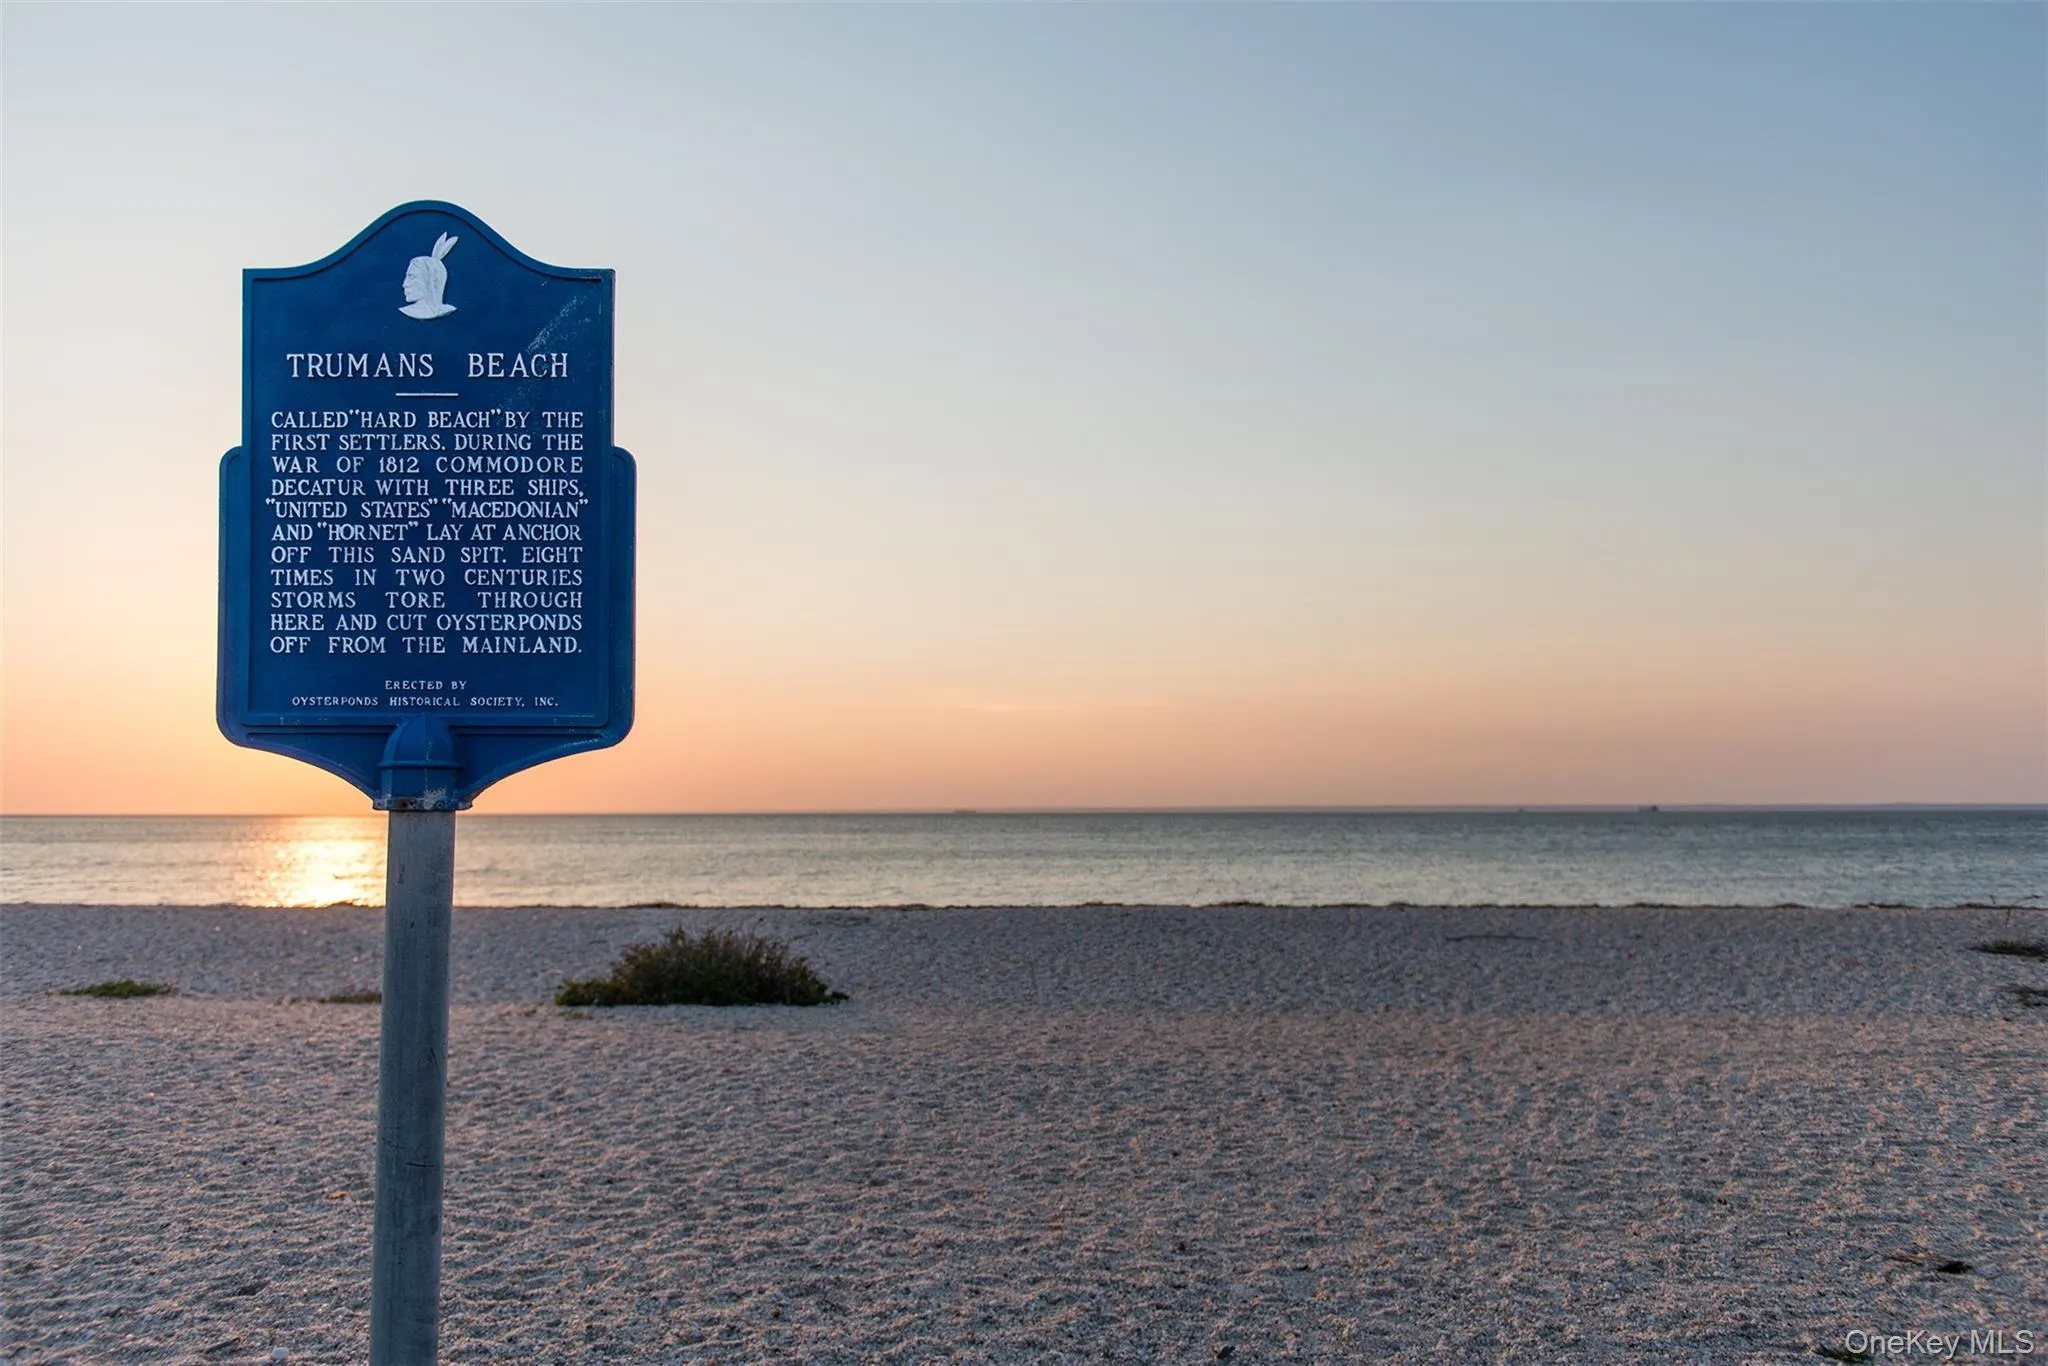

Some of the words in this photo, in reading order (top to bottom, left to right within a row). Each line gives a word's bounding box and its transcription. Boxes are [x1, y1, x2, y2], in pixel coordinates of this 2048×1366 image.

[286, 352, 434, 378] TRUMANS
[468, 352, 568, 378] BEACH
[271, 411, 349, 429] CALLED
[504, 411, 531, 428] BY
[542, 411, 584, 429] THE
[271, 433, 331, 451] FIRST
[338, 433, 446, 451] SETTLERS.
[454, 433, 532, 451] DURING
[542, 433, 584, 451] THE
[271, 455, 320, 474] WAR
[336, 456, 364, 473] OF
[379, 456, 420, 473] 1812
[435, 455, 583, 474] COMMODORE
[271, 478, 366, 496] DECATUR
[374, 478, 429, 496] WITH
[444, 478, 515, 496] THREE
[527, 478, 584, 498] SHIPS,
[271, 523, 313, 542] AND
[426, 523, 462, 541] LAY
[470, 523, 497, 541] AT
[502, 523, 582, 541] ANCHOR
[271, 545, 312, 564] OFF
[328, 546, 375, 564] THIS
[391, 546, 446, 564] SAND
[460, 546, 507, 564] SPIT.
[521, 546, 583, 564] EIGHT
[270, 568, 334, 586] TIMES
[355, 568, 377, 586] IN
[395, 568, 445, 586] TWO
[464, 568, 583, 586] CENTURIES
[271, 590, 356, 609] STORMS
[384, 591, 445, 609] TORE
[477, 591, 583, 609] THROUGH
[270, 613, 325, 631] HERE
[335, 613, 377, 631] AND
[386, 614, 427, 631] CUT
[436, 613, 583, 631] OYSTERPONDS
[270, 636, 311, 654] OFF
[328, 635, 386, 654] FROM
[402, 636, 446, 654] THE
[462, 636, 582, 654] MAINLAND.
[385, 680, 444, 690] ERECTED
[451, 680, 467, 690] BY
[292, 696, 379, 706] OYSTERPONDS
[389, 696, 461, 706] HISTORICAL
[470, 696, 526, 707] SOCIETY,
[534, 696, 560, 706] INC.
